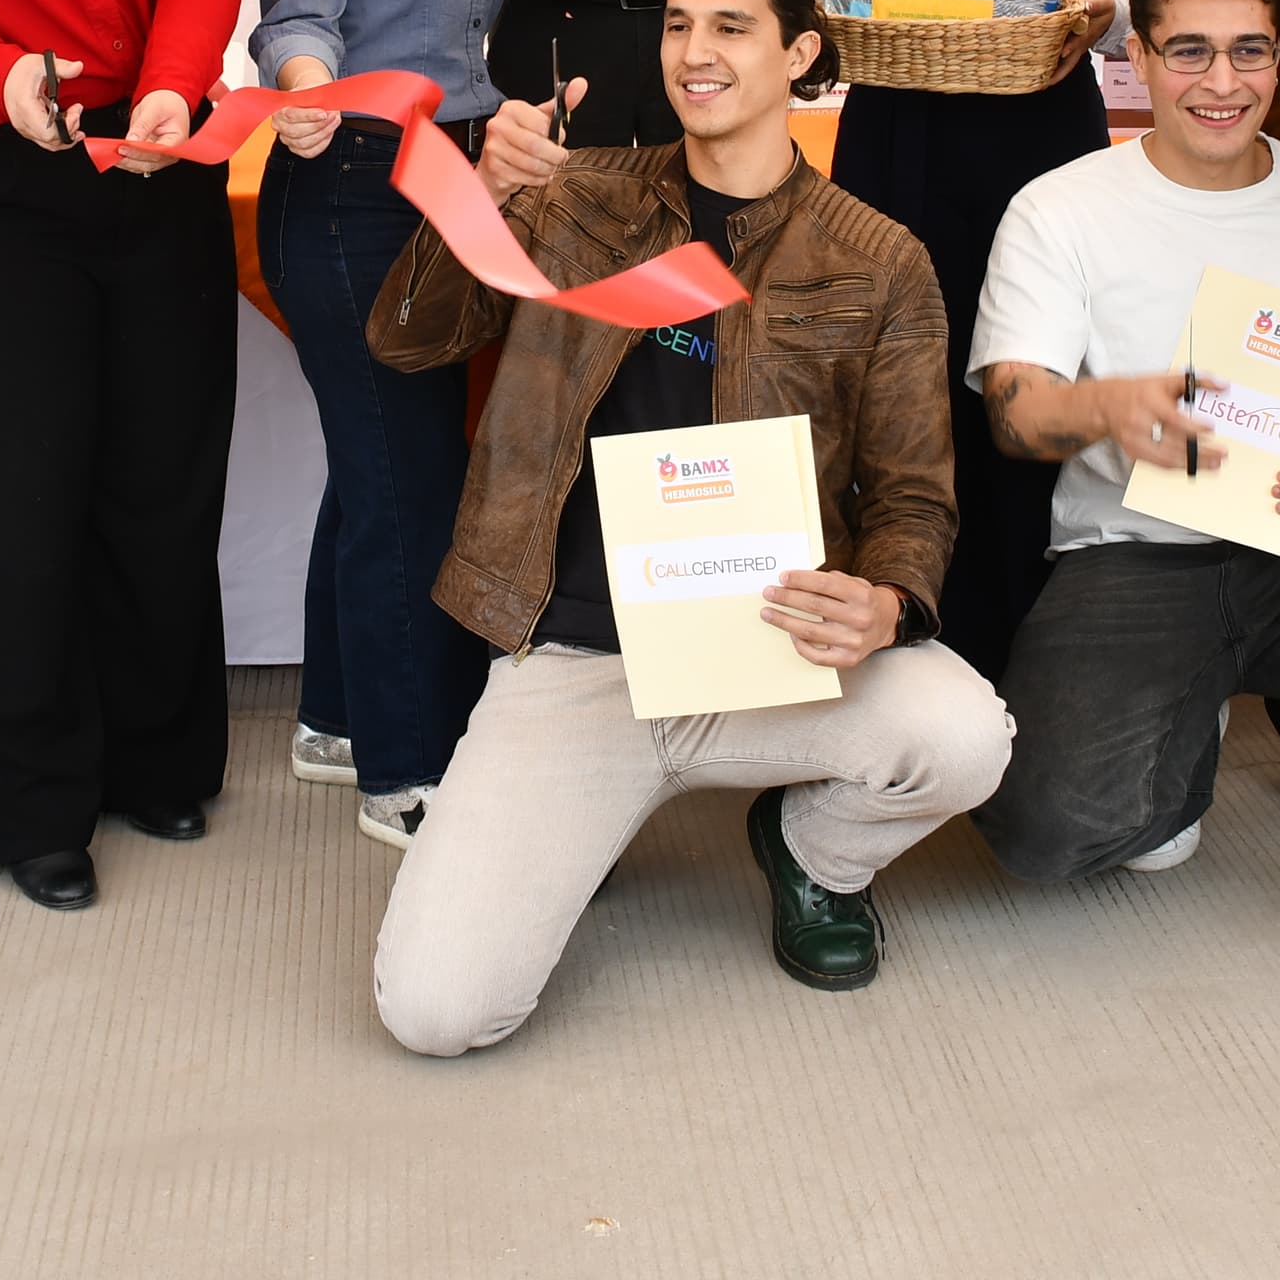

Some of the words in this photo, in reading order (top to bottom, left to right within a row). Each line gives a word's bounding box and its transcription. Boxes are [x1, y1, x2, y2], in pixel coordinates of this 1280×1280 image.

[645, 324, 715, 365] CENT
[680, 458, 730, 477] BAMX
[664, 484, 733, 501] HERMOSILLO
[655, 555, 777, 578] CALLCENTERED
